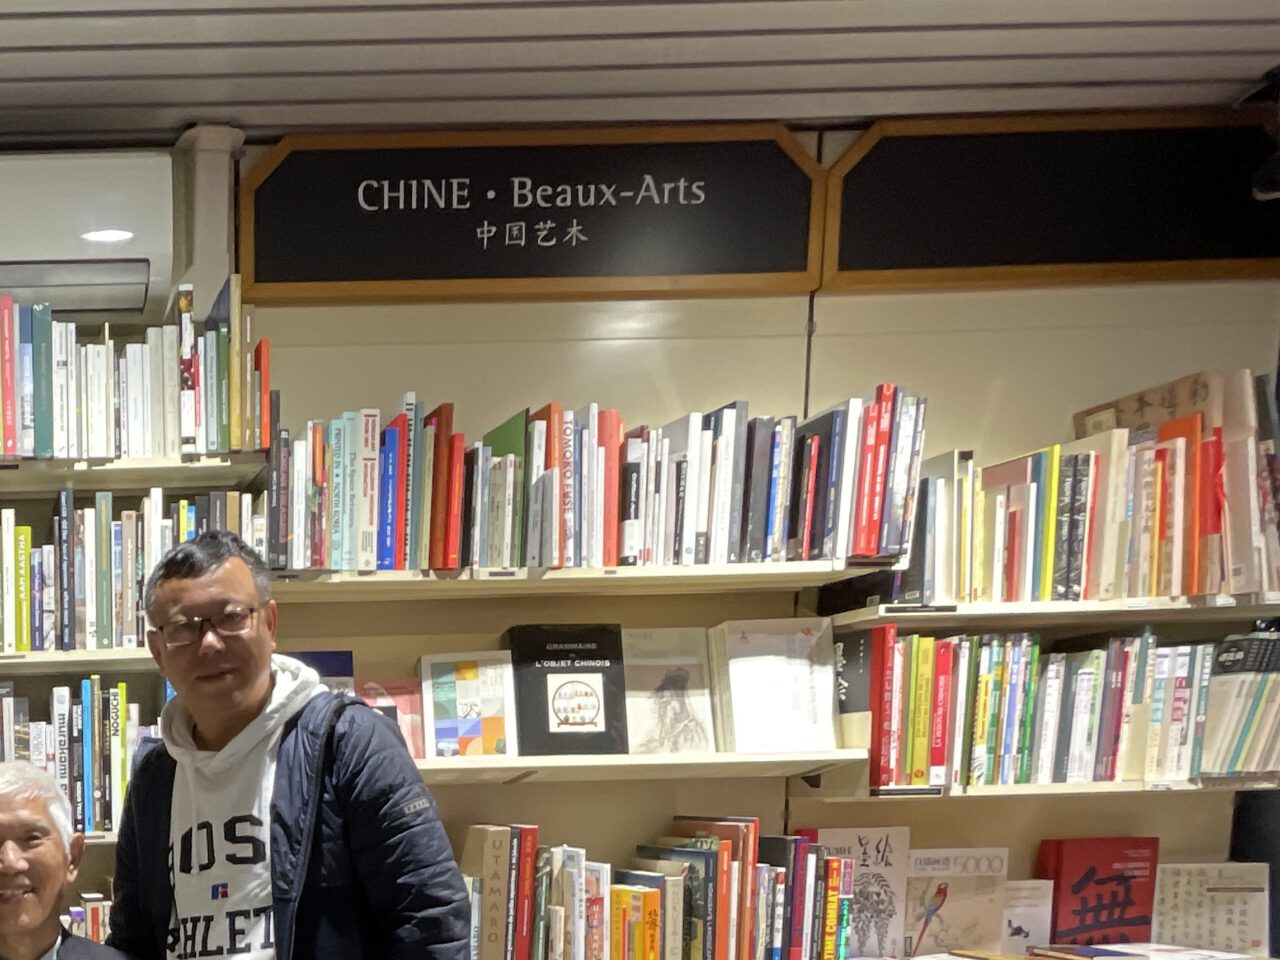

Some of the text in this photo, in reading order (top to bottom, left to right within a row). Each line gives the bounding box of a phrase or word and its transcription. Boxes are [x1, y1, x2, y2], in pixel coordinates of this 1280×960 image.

[357, 174, 706, 210] CHINE Beaux-Arts
[333, 427, 343, 535] PRINTED IN NORTH KOREA
[348, 452, 358, 470] The
[562, 419, 574, 514] TOMOKO FUSE
[348, 493, 358, 528] Between
[535, 658, 611, 667] L'OBJET CHINOIS
[545, 642, 598, 650] GRAMMAIRE
[111, 691, 121, 737] NOGUCHI
[57, 713, 70, 779] murakami
[487, 838, 505, 944] UTAMARO
[705, 882, 715, 922] HOKUSAI'S
[825, 889, 839, 933] COMBAT
